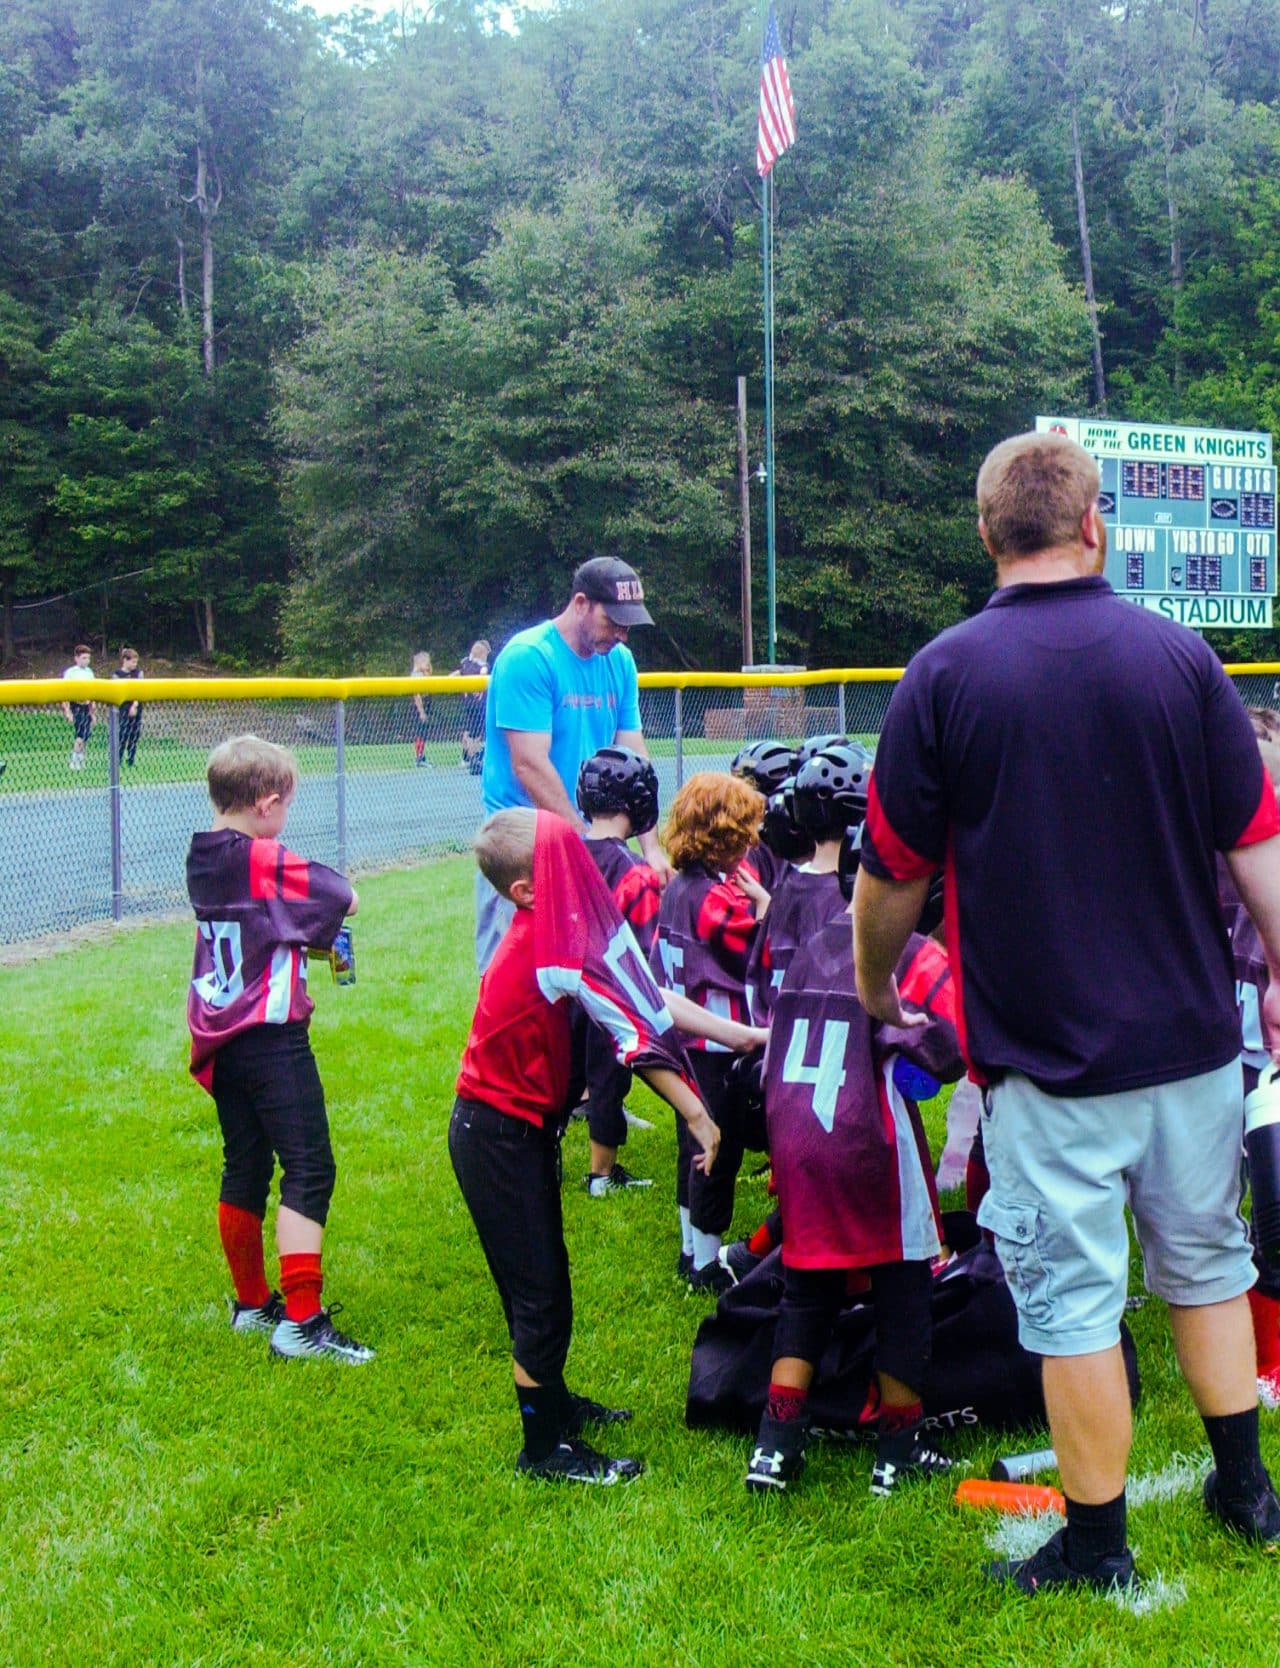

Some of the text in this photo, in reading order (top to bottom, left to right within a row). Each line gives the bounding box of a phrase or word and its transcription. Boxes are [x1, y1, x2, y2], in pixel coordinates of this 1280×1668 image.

[1084, 438, 1122, 450] OF THE
[1088, 427, 1118, 438] HOME
[1128, 431, 1267, 459] GREEN KNIGHTS
[1212, 466, 1271, 492] GUESTS
[1115, 528, 1155, 552] DOWN
[1172, 530, 1234, 555] YDS TO GO
[1246, 533, 1270, 556] QTR
[1159, 597, 1267, 624] STADIUM
[782, 1018, 850, 1133] 4
